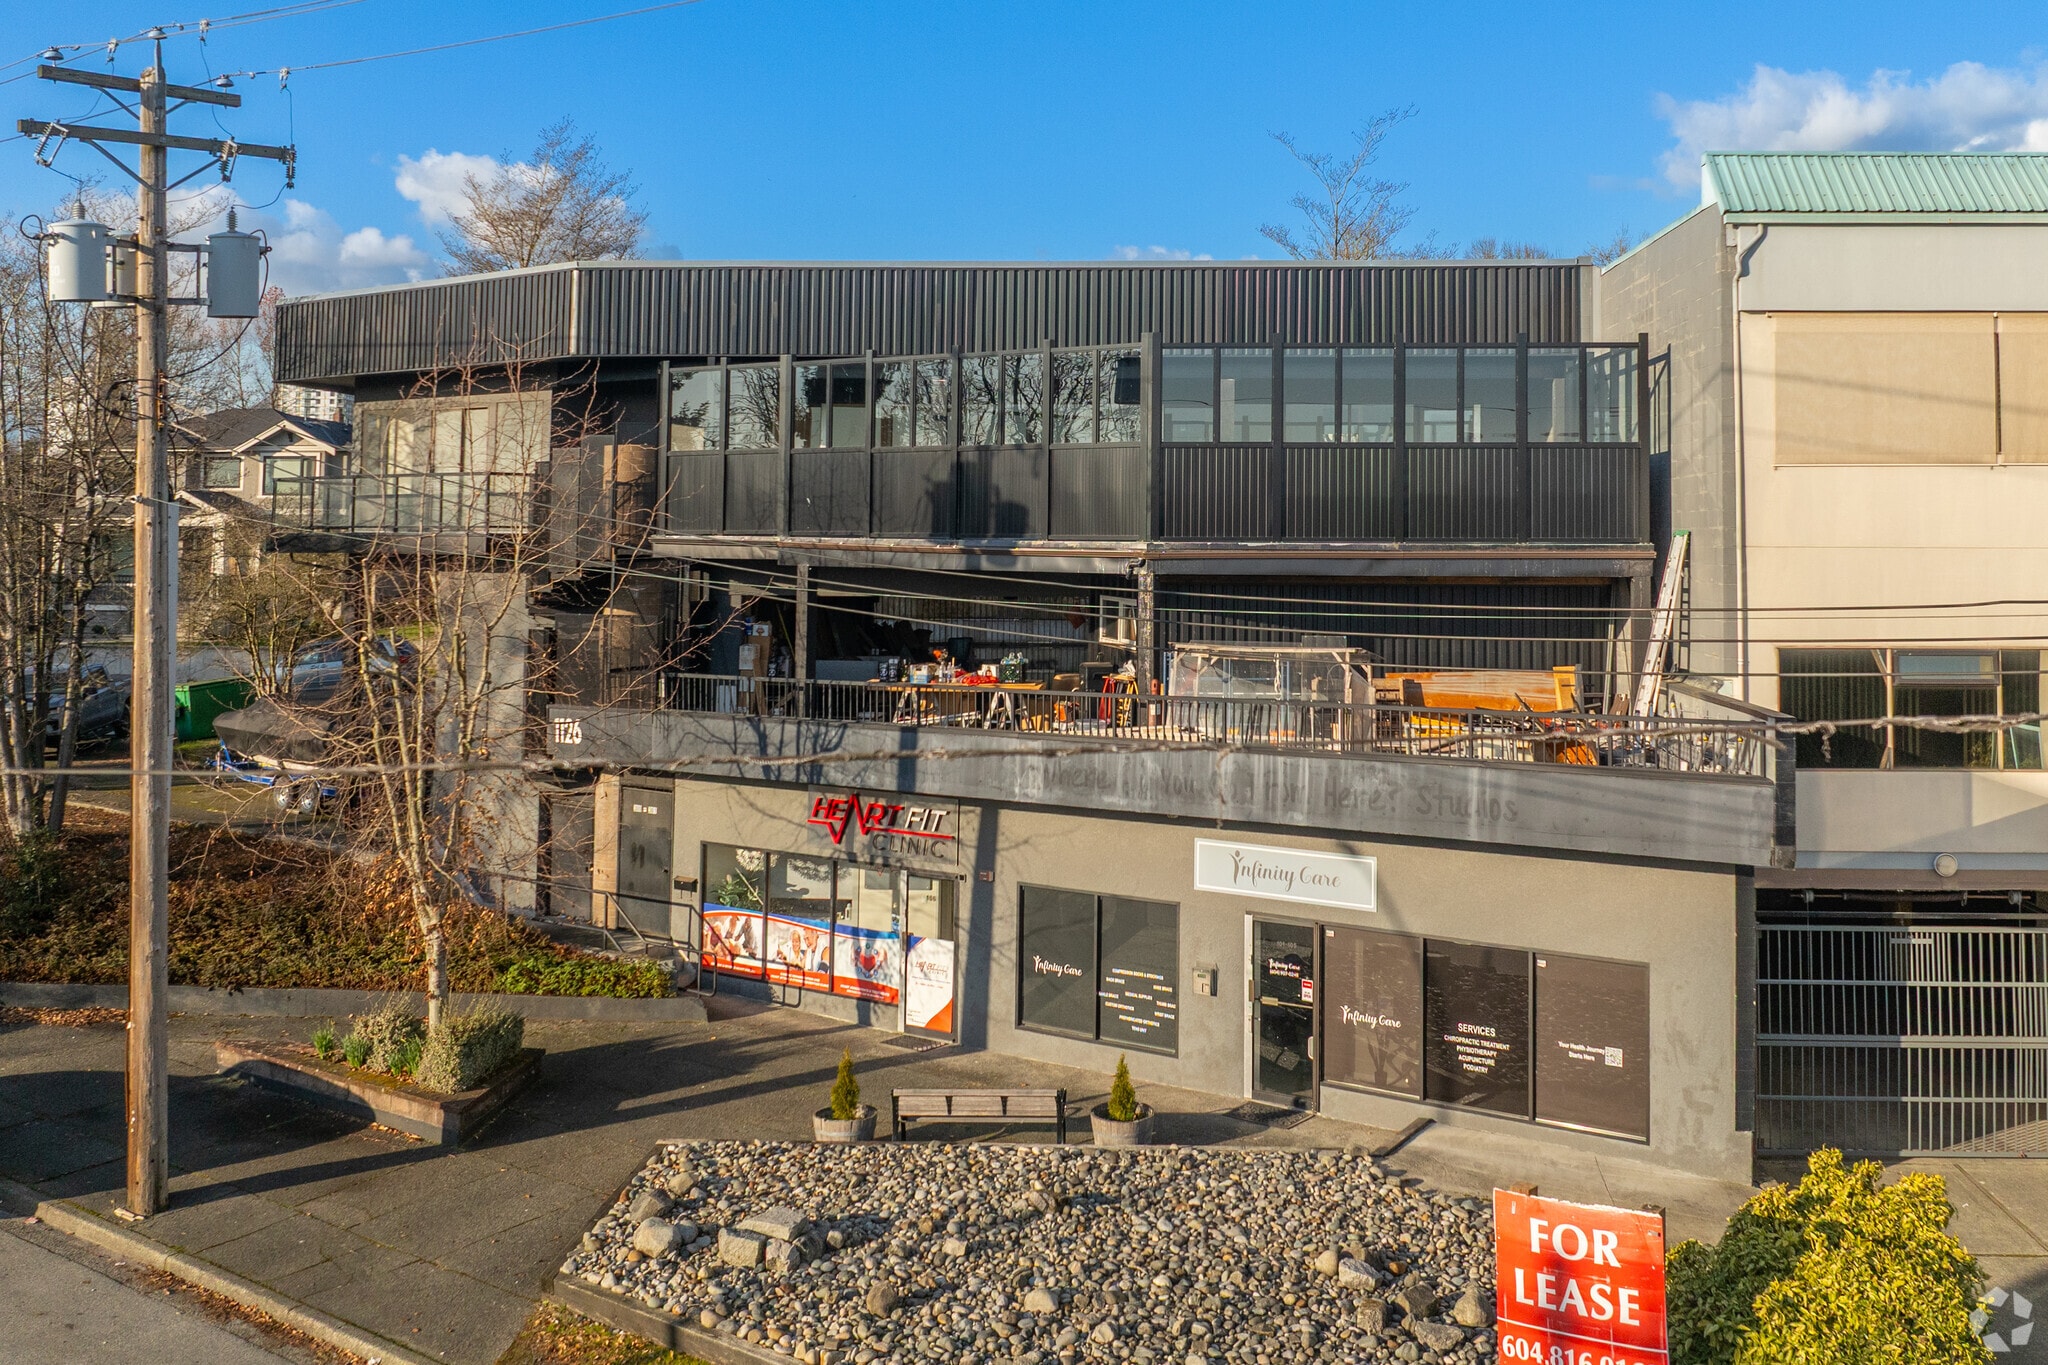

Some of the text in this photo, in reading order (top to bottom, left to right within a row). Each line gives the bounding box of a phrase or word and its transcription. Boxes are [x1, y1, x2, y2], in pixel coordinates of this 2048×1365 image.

[554, 718, 582, 745] 1126
[809, 793, 950, 840] HEART FIT
[872, 834, 946, 858] CLINIC
[1229, 849, 1342, 892] Infinity Care
[1033, 955, 1083, 977] Infinity Care
[1340, 1005, 1402, 1029] Infinity Care
[1457, 1022, 1496, 1037] SERVICES
[1444, 1034, 1510, 1051] CHIROPRACTIC TREATMENT
[1456, 1045, 1498, 1058] PHYSIOTHERAPY
[1570, 1043, 1585, 1052] Health
[1585, 1046, 1605, 1056] Journey
[1458, 1054, 1496, 1066] ACUPUNCTURE
[1463, 1063, 1489, 1074] PODIATRY
[1583, 1054, 1595, 1062] Here
[1529, 1217, 1622, 1269] FOR
[1514, 1267, 1641, 1327] LEASE
